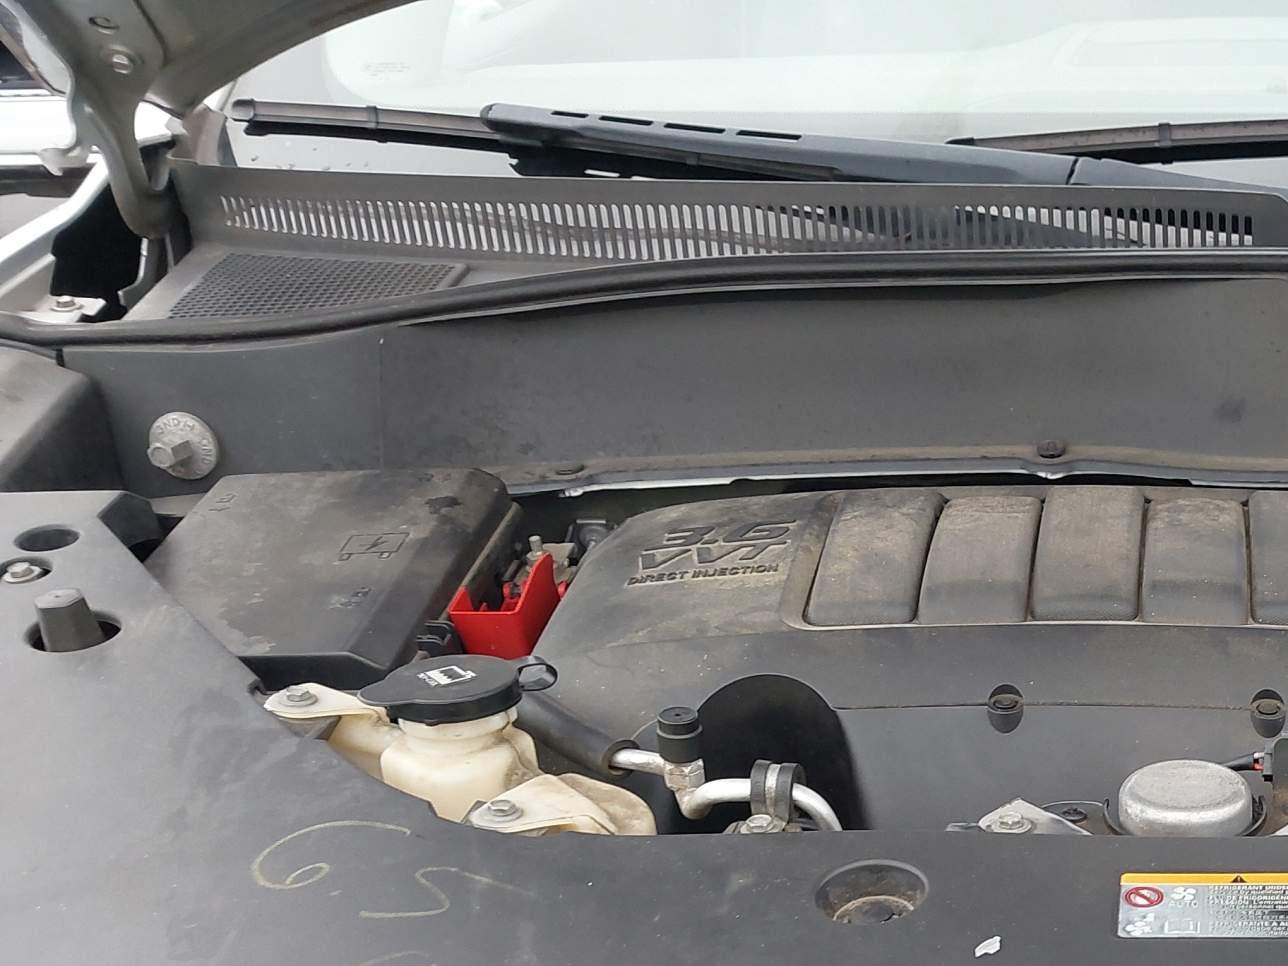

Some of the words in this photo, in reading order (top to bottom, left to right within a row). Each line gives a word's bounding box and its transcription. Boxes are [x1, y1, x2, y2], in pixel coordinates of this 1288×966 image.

[663, 519, 797, 546] 3.6
[639, 540, 791, 571] VVT
[625, 569, 690, 587] DIRECT
[690, 563, 780, 580] INJECTION
